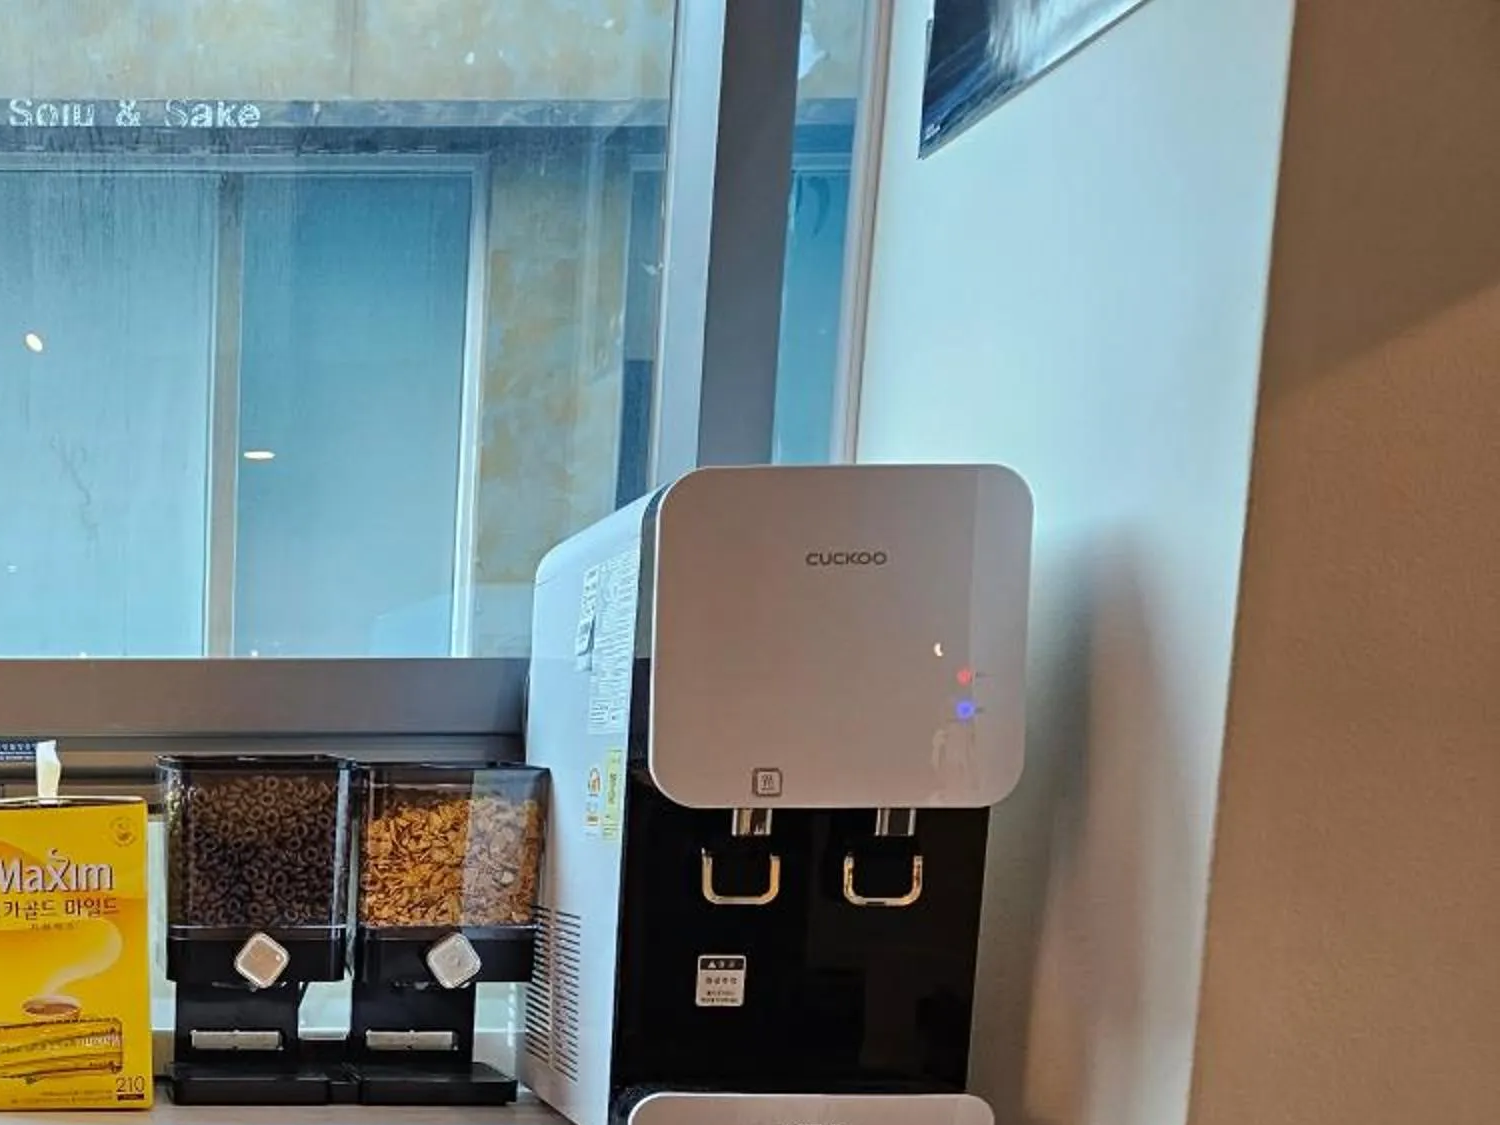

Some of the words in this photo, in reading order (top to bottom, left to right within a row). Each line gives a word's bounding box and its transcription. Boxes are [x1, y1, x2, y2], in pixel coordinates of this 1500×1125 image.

[115, 99, 141, 127] &
[164, 98, 261, 128] Sake
[806, 552, 888, 566] CUCKOO
[64, 897, 119, 917] 마일드
[115, 1075, 146, 1093] 210
